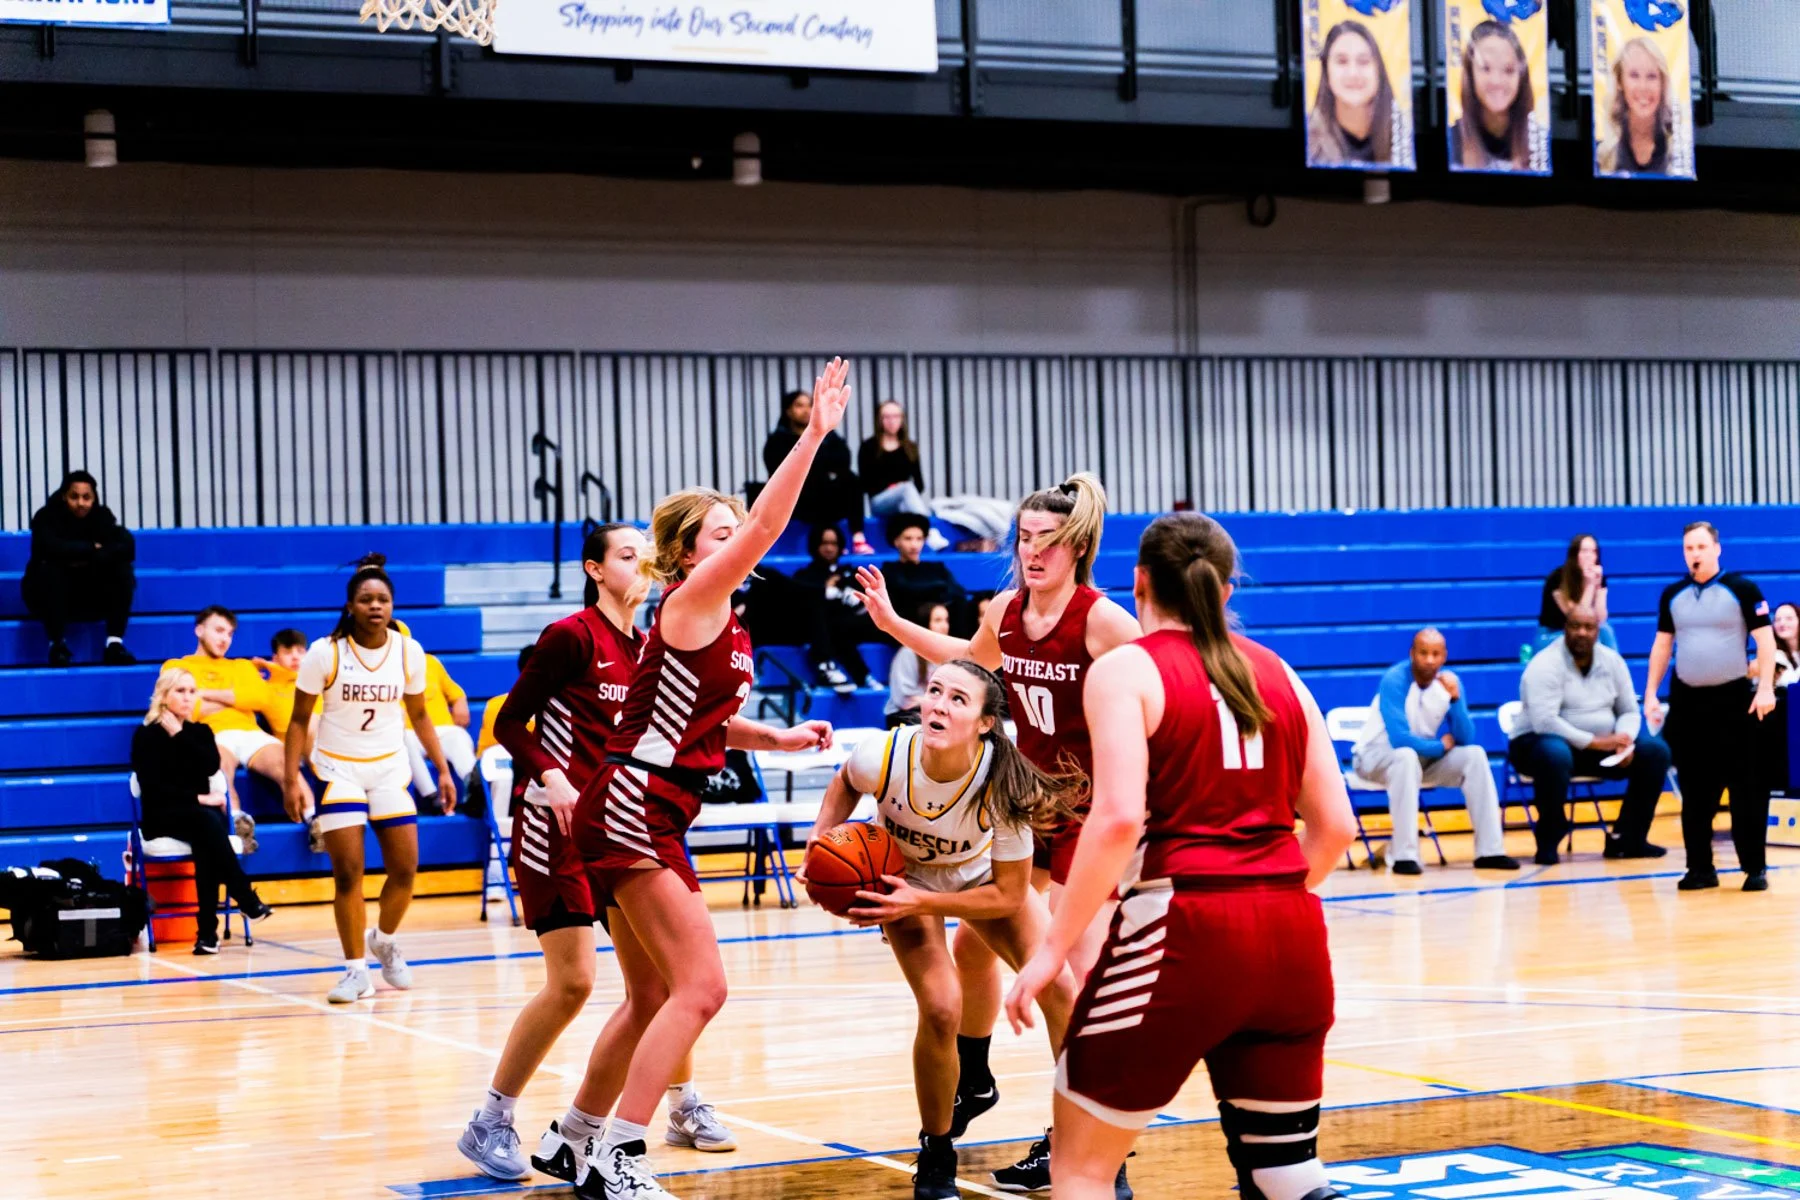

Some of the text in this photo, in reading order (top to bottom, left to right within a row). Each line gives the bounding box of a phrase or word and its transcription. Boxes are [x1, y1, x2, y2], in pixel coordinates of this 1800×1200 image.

[559, 2, 873, 48] Stepping into Our Second Century
[342, 683, 398, 702] BRESCIA
[598, 682, 629, 702] SOU
[361, 708, 375, 731] 2
[1011, 682, 1056, 736] 10
[884, 815, 972, 855] BRESCIA
